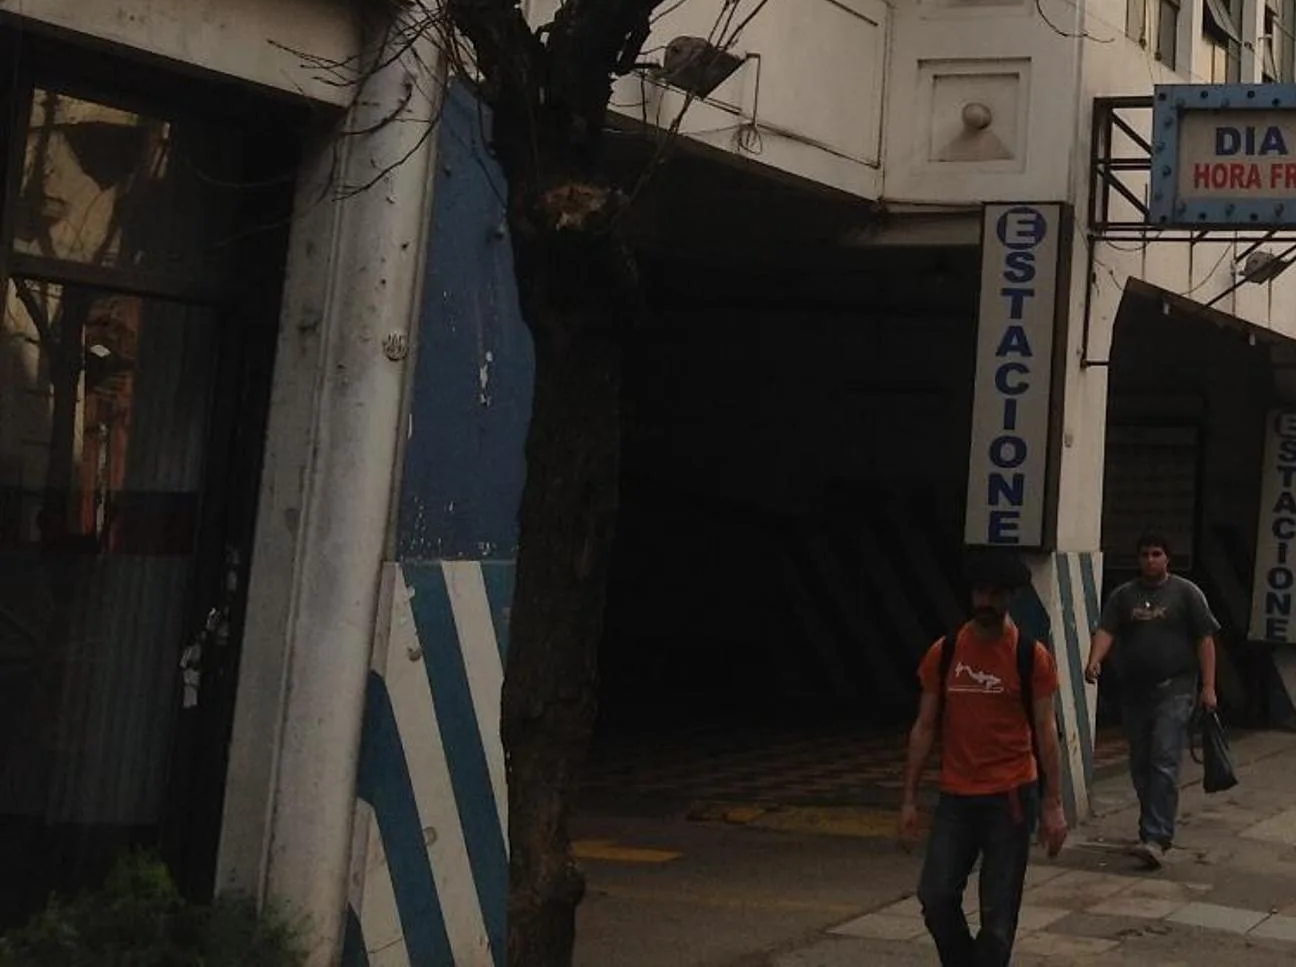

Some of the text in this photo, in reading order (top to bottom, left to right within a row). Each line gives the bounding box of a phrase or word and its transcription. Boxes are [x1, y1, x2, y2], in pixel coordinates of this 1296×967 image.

[1215, 126, 1288, 156] DIA
[1194, 163, 1262, 190] HORA
[988, 210, 1040, 544] ESTACIONE
